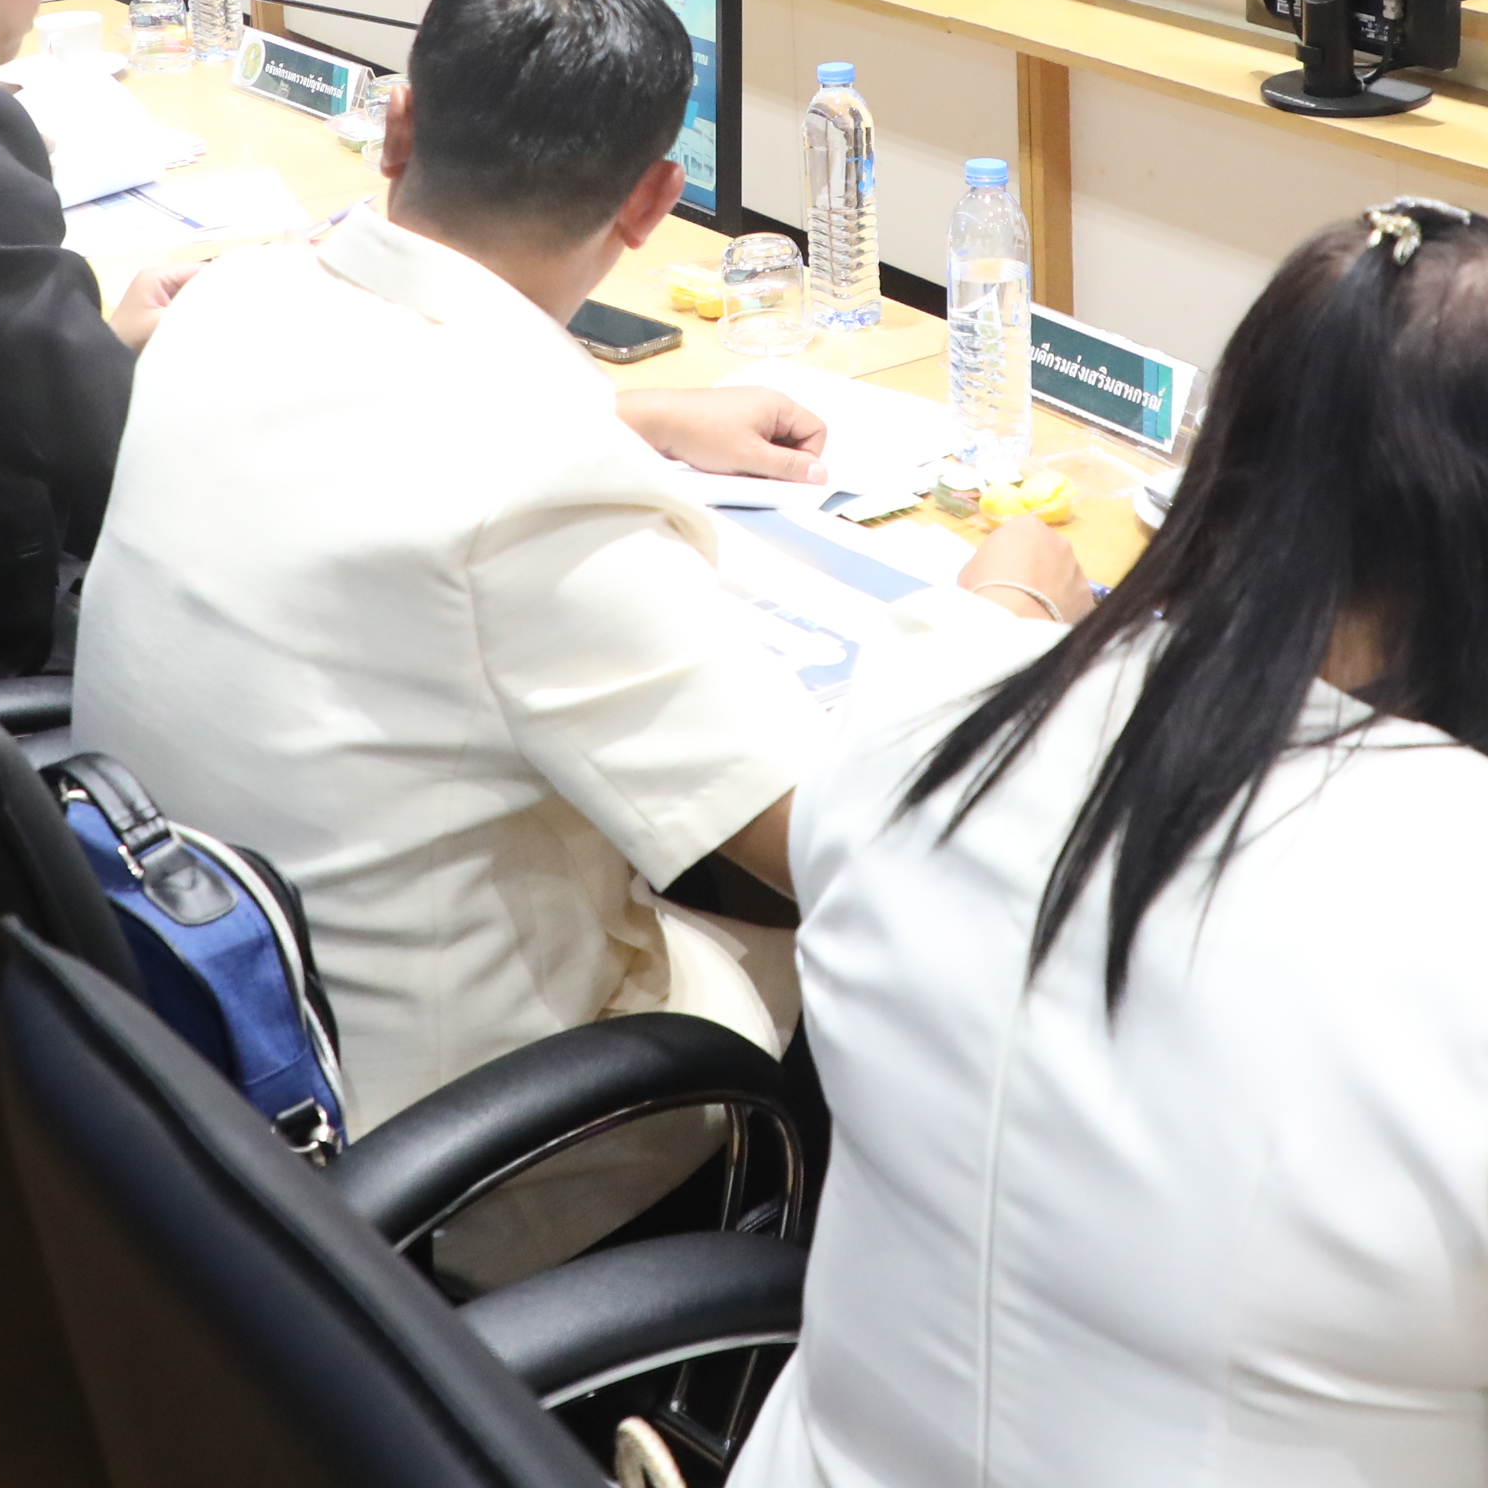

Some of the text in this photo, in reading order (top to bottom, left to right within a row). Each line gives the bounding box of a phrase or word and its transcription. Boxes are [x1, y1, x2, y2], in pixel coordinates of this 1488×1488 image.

[1030, 342, 1166, 413] บดีกรมส่งเสริมสหกรณ์
